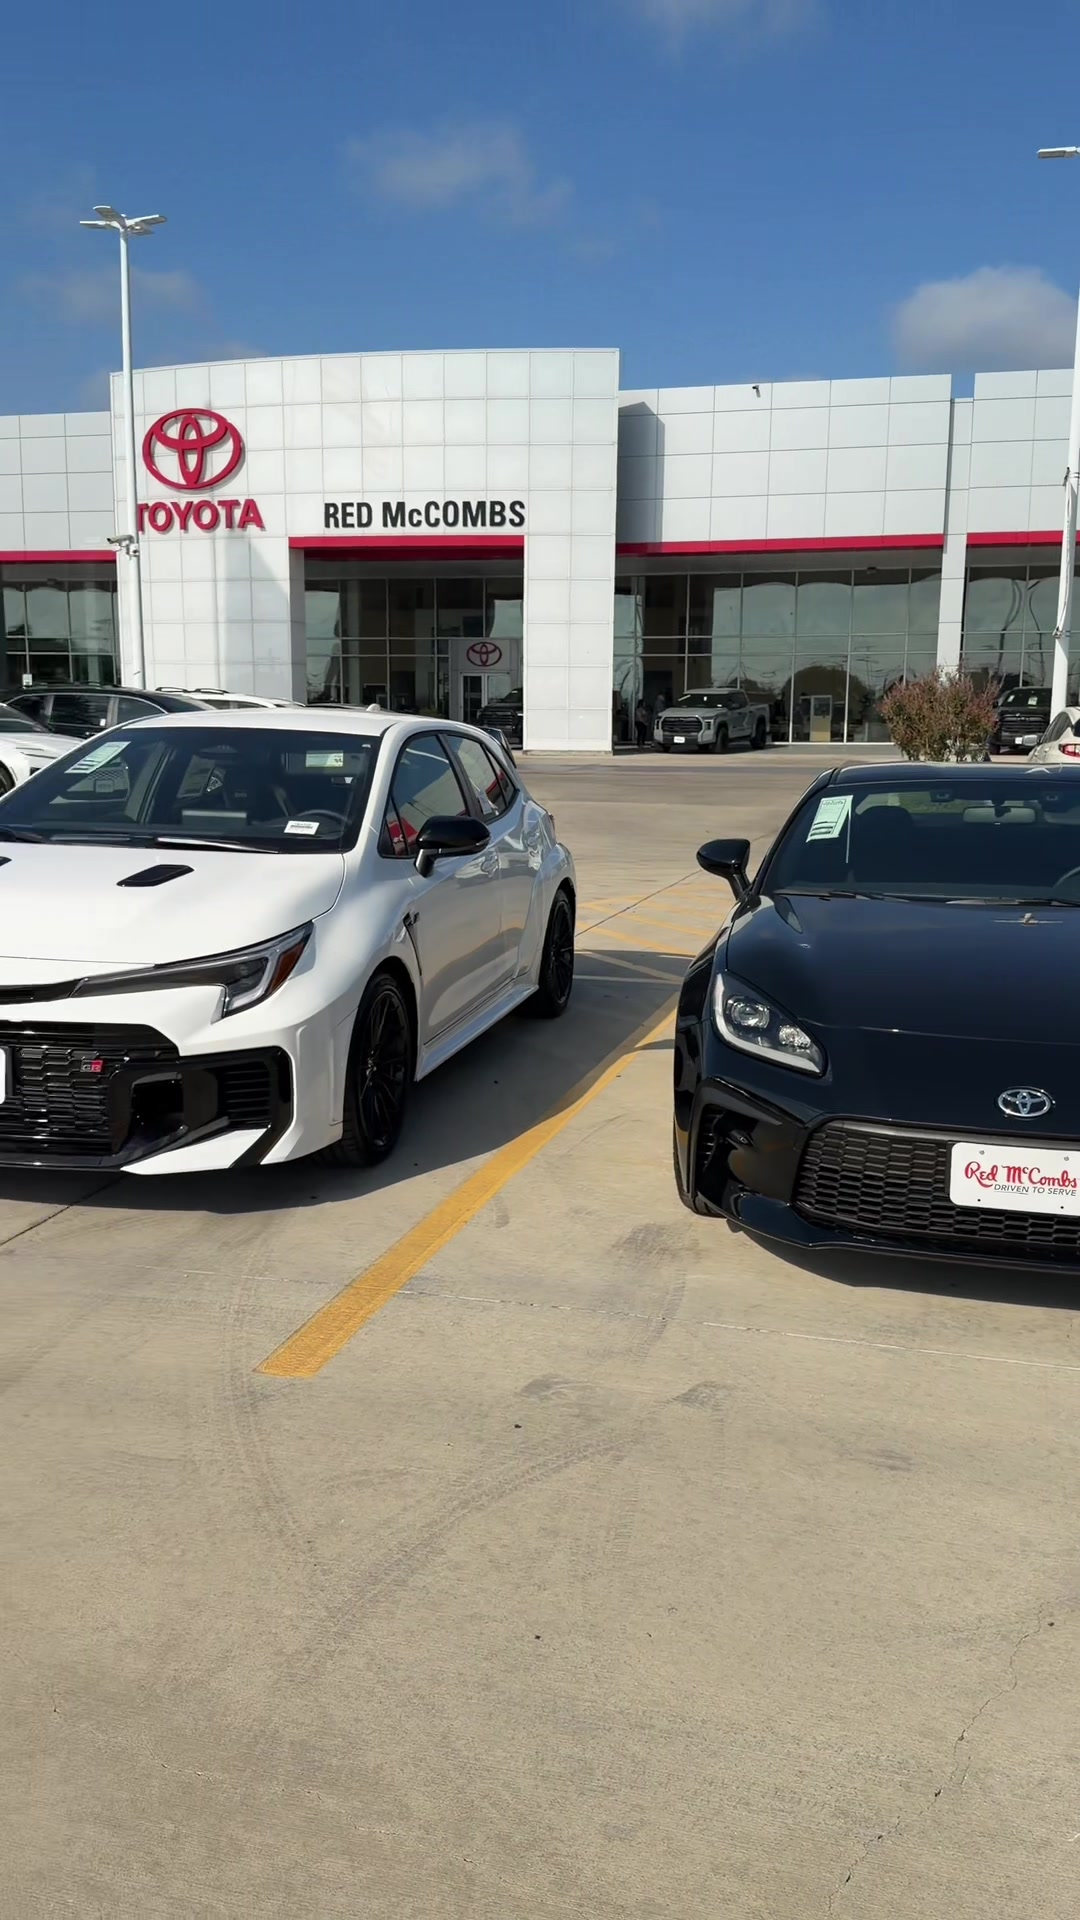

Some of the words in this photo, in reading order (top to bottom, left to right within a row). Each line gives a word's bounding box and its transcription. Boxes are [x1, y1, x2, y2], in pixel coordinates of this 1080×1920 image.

[137, 499, 264, 532] TOYOTA
[324, 502, 373, 528] RED
[382, 500, 526, 528] McCOMBS
[964, 1161, 998, 1188] Red
[1001, 1165, 1078, 1188] McCombs
[994, 1184, 1030, 1193] DRIVEN
[1047, 1188, 1077, 1196] SERVE
